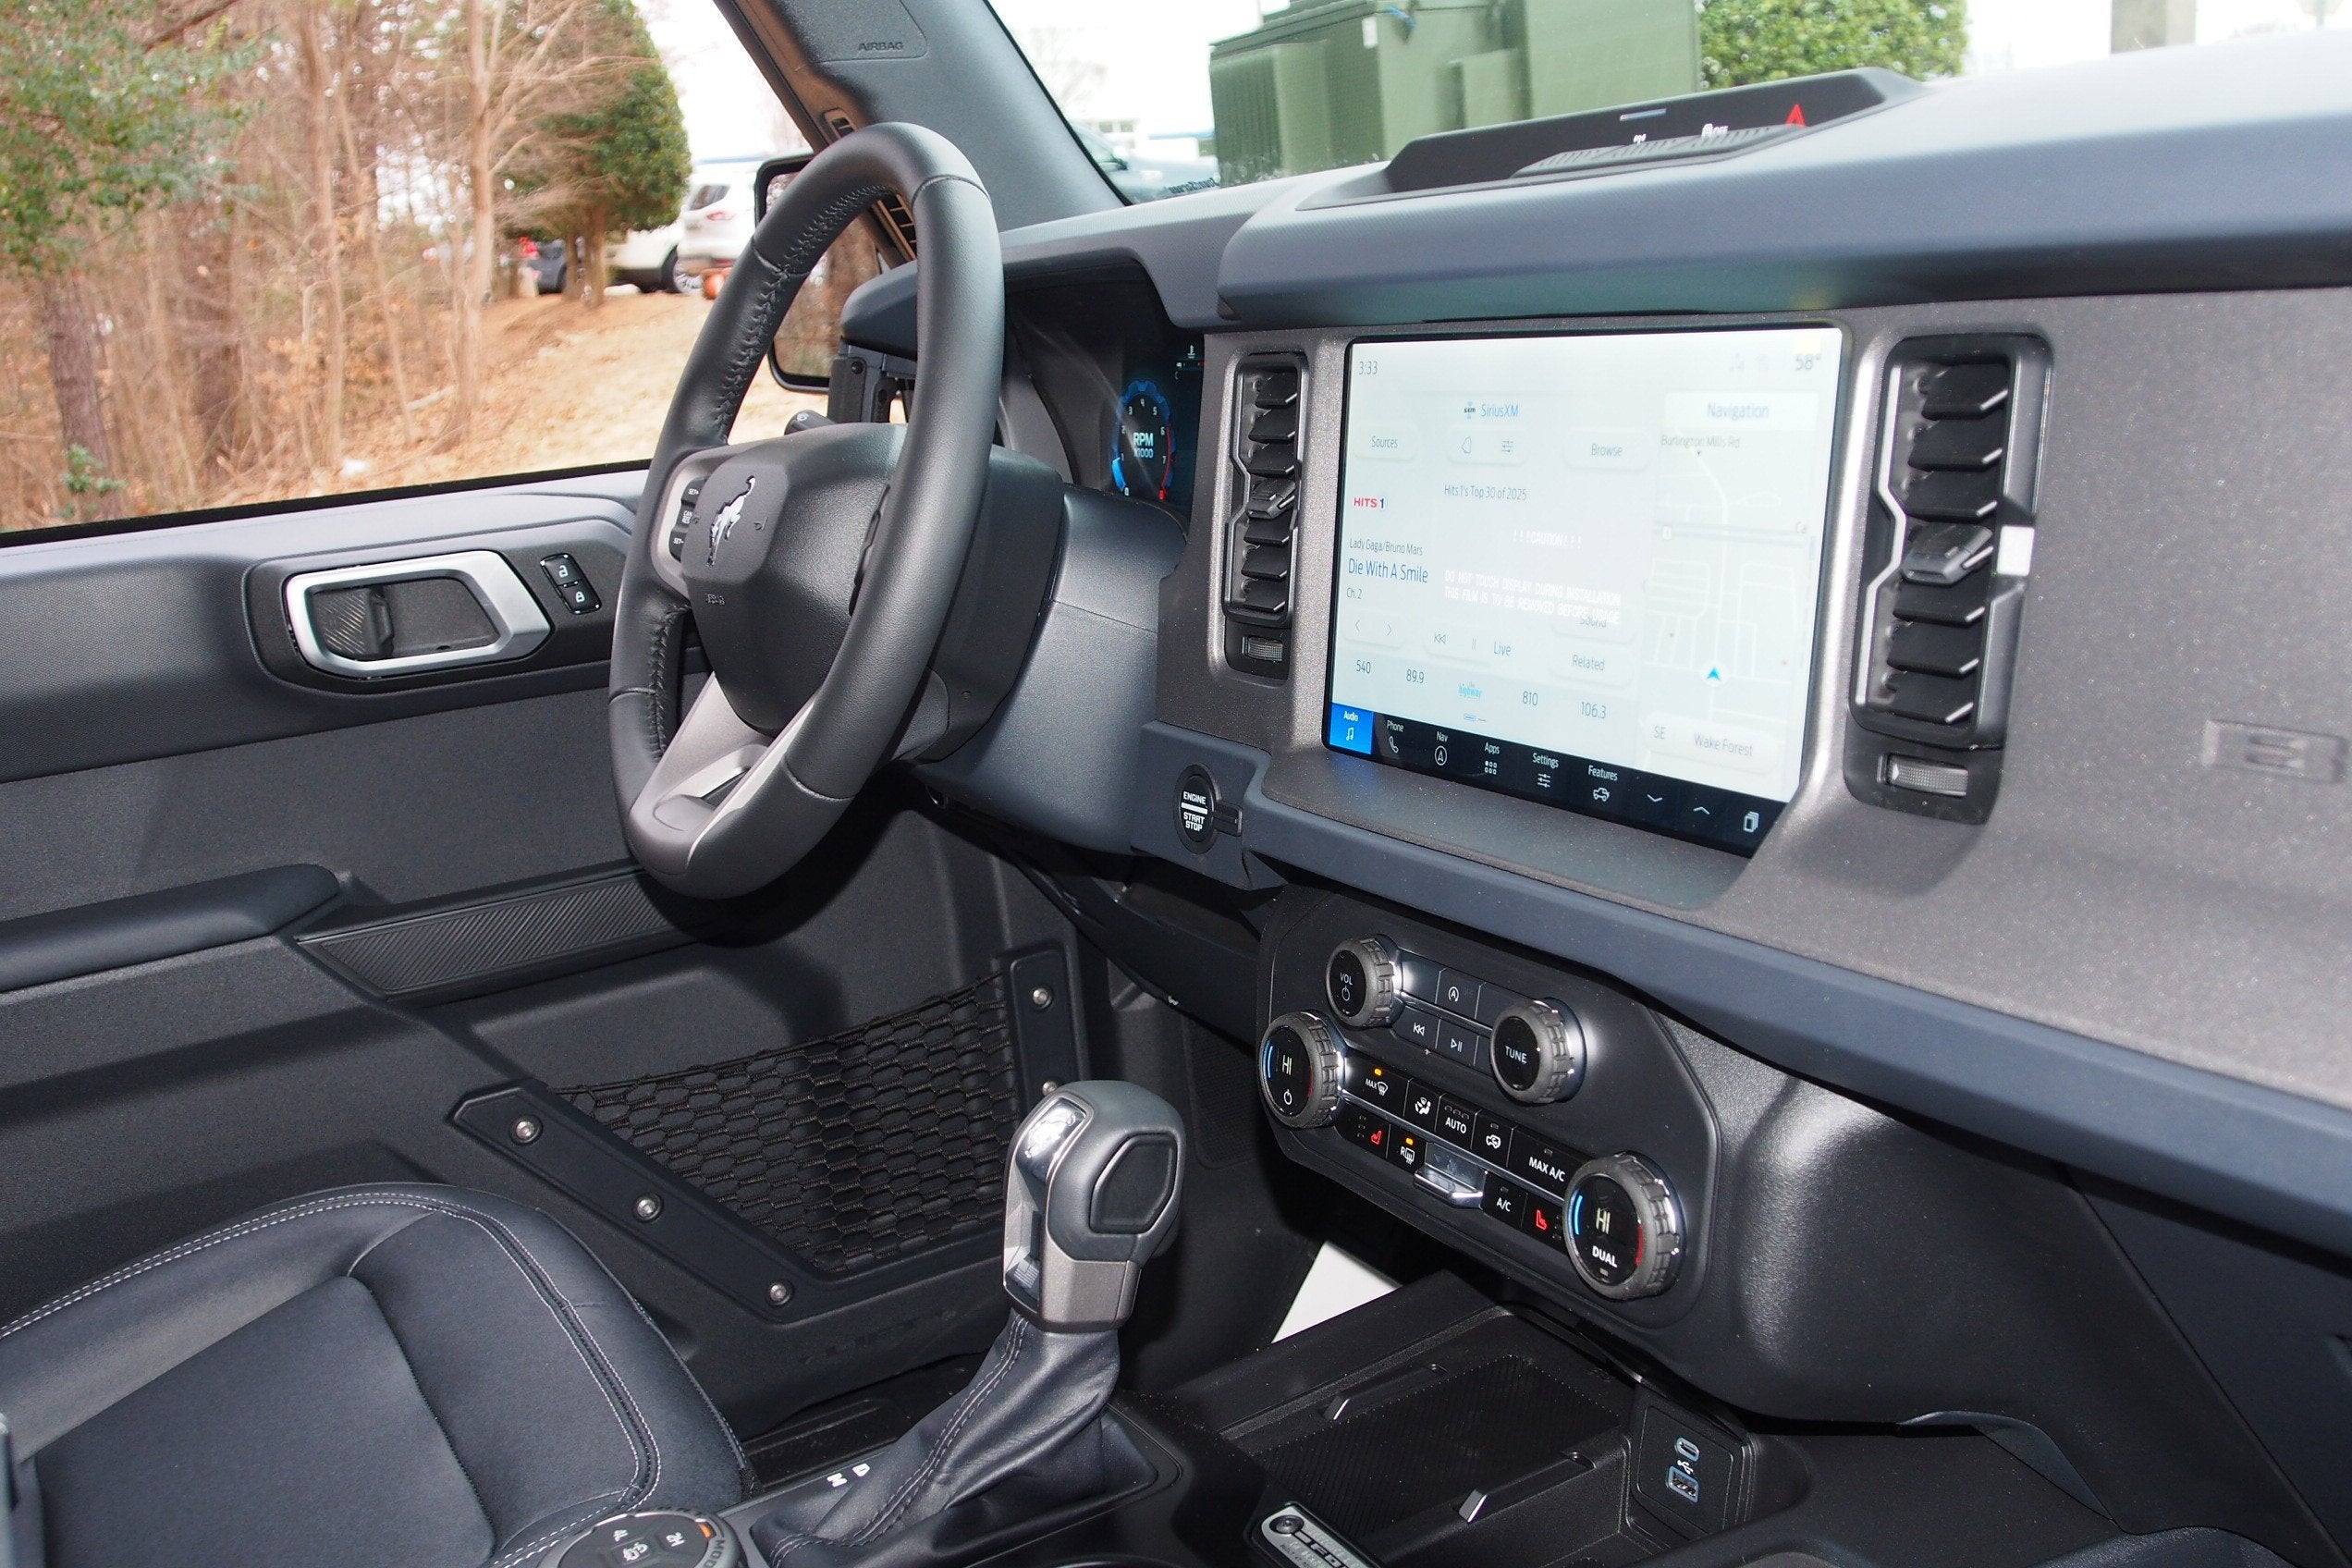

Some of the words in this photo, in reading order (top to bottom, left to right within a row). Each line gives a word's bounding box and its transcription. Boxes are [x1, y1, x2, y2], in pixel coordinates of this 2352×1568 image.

[857, 42, 904, 51] AIRBAG
[1358, 361, 1378, 375] 3:33
[1481, 403, 1519, 418] SiriusXM
[1708, 402, 1770, 421] Navigation
[1133, 432, 1154, 447] RPM
[1371, 435, 1399, 449] Sources
[1660, 435, 1704, 449] Burlington
[1706, 435, 1725, 448] Mills
[1728, 436, 1741, 448] Rd
[1590, 443, 1623, 457] Browse
[1444, 484, 1459, 496] Hits
[1470, 485, 1485, 499] Top
[1486, 486, 1496, 499] 30
[1497, 487, 1507, 499] of
[1506, 488, 1528, 501] 2025
[1354, 496, 1378, 508] HITS
[1378, 497, 1385, 509] 1
[1349, 538, 1365, 551] Lady
[1366, 539, 1405, 554] Gaga/Bruno
[1406, 543, 1424, 556] Mars
[1348, 557, 1364, 574] Die
[1366, 560, 1389, 579] With
[1390, 562, 1398, 580] A
[1400, 563, 1428, 583] Smile
[1444, 570, 1455, 582] DO
[1457, 570, 1473, 584] NOT
[1476, 573, 1499, 588] TOUCH
[1502, 577, 1533, 594] DISPLAY
[1535, 582, 1563, 599] DURING
[1566, 585, 1622, 606] INSTALLATION
[1444, 586, 1459, 600] THIS
[1462, 588, 1479, 602] FILM
[1480, 591, 1488, 604] IS
[1491, 593, 1501, 606] TO
[1504, 594, 1515, 608] BE
[1517, 596, 1555, 614] REMOVED
[1558, 602, 1589, 619] BEFORE
[1591, 606, 1621, 625] USAGE
[1494, 641, 1513, 656] Live
[1355, 659, 1371, 674] 540
[1572, 654, 1606, 671] Related
[1405, 669, 1425, 684] 89.9
[1522, 690, 1538, 705] 810
[1343, 710, 1359, 721] Audio
[1581, 701, 1607, 719] 106.3
[1386, 719, 1404, 732] Phone
[1653, 725, 1667, 740] SE
[1437, 730, 1448, 742] Nav
[1484, 741, 1500, 755] Apps
[1694, 731, 1721, 751] Wake
[1722, 738, 1753, 757] Forest
[1532, 752, 1559, 769] Settings
[1587, 765, 1618, 782] Features
[1183, 790, 1206, 804] ENGINE
[1183, 812, 1205, 825] START
[1185, 819, 1203, 832] STOP
[1340, 972, 1354, 986] VOL
[1504, 1046, 1527, 1064] TUNE
[1281, 1054, 1292, 1076] HI
[1365, 1078, 1378, 1090] MAX
[1445, 1117, 1467, 1134] AUTO
[1529, 1157, 1549, 1174] MAX
[1549, 1166, 1565, 1182] A/C
[1496, 1196, 1512, 1213] A/C
[1595, 1207, 1611, 1234] HI
[1592, 1245, 1618, 1268] DUAL
